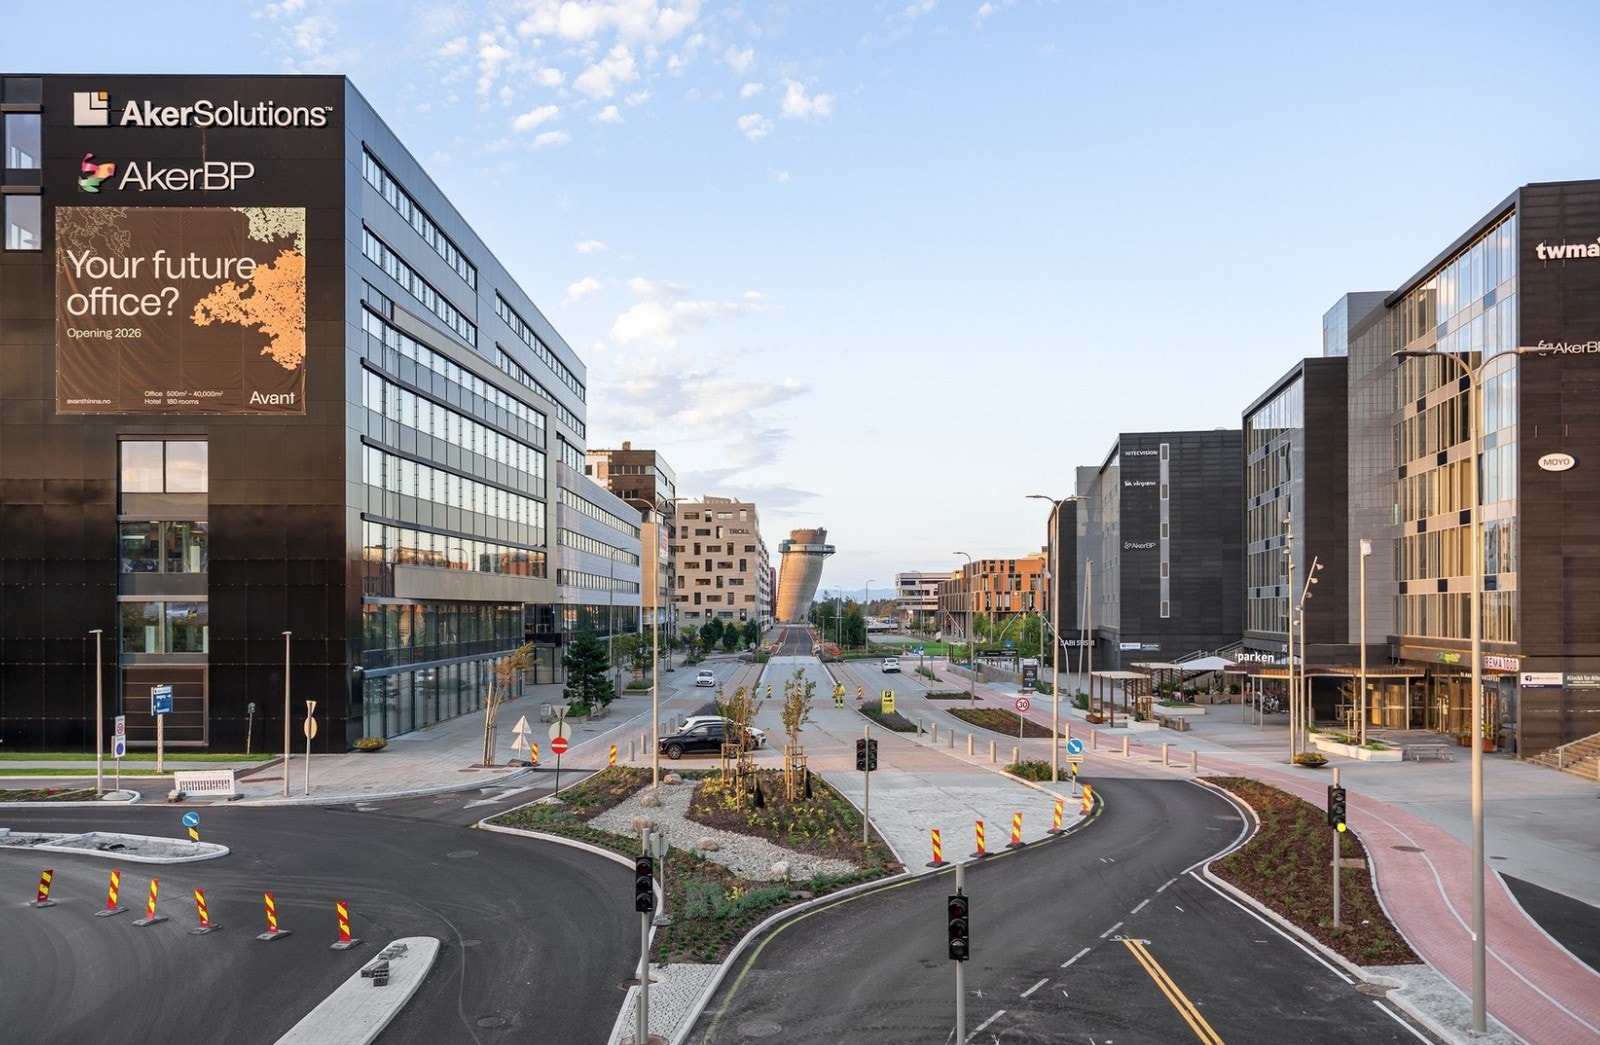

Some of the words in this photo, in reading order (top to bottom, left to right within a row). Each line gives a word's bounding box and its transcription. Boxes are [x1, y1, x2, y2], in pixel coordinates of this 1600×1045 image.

[118, 161, 255, 191] AkerBP
[1536, 236, 1600, 260] twma
[66, 250, 145, 279] Your
[152, 250, 257, 280] future
[66, 286, 180, 316] office?
[66, 328, 113, 340] Opening
[114, 328, 142, 338] 2026
[1553, 341, 1600, 354] AkerB
[249, 391, 296, 405] Avant
[1543, 458, 1570, 466] MOYO
[1237, 652, 1275, 663] parken
[1019, 701, 1028, 709] 30
